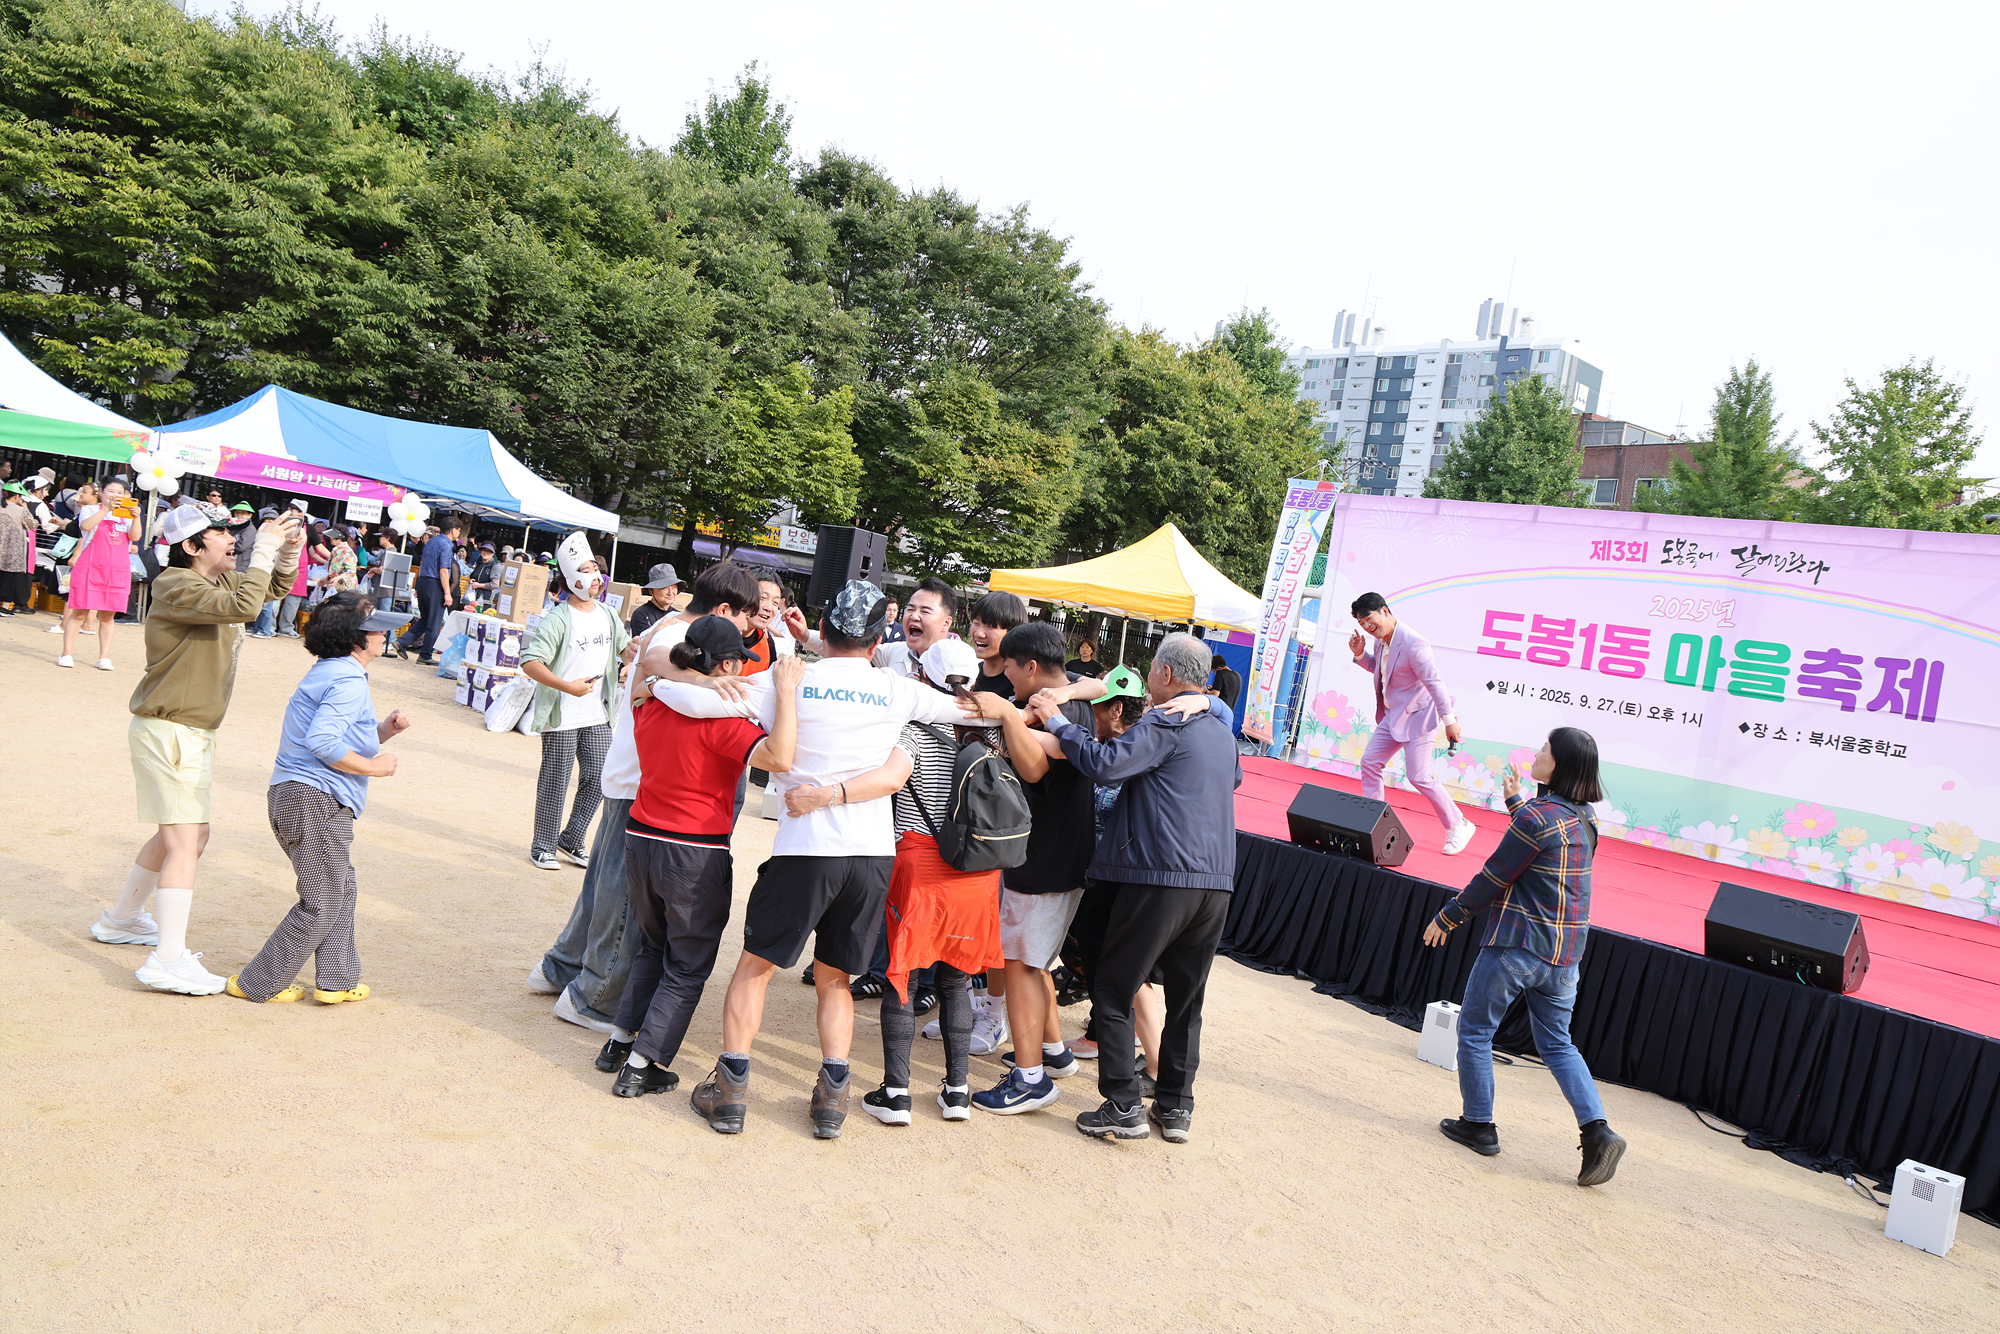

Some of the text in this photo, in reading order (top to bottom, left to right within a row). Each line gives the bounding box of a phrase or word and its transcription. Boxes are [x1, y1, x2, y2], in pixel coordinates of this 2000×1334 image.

[260, 464, 361, 493] 서원암 나눔마당
[1589, 540, 1649, 563] 제3회
[1260, 532, 1312, 691] 우리 모두의 축제
[1649, 595, 1736, 628] 2025년
[1477, 609, 1651, 680] 도봉1동
[1647, 706, 1675, 722] 오후
[1682, 711, 1704, 728] 1시
[1809, 730, 1908, 759] 북서울중학교
